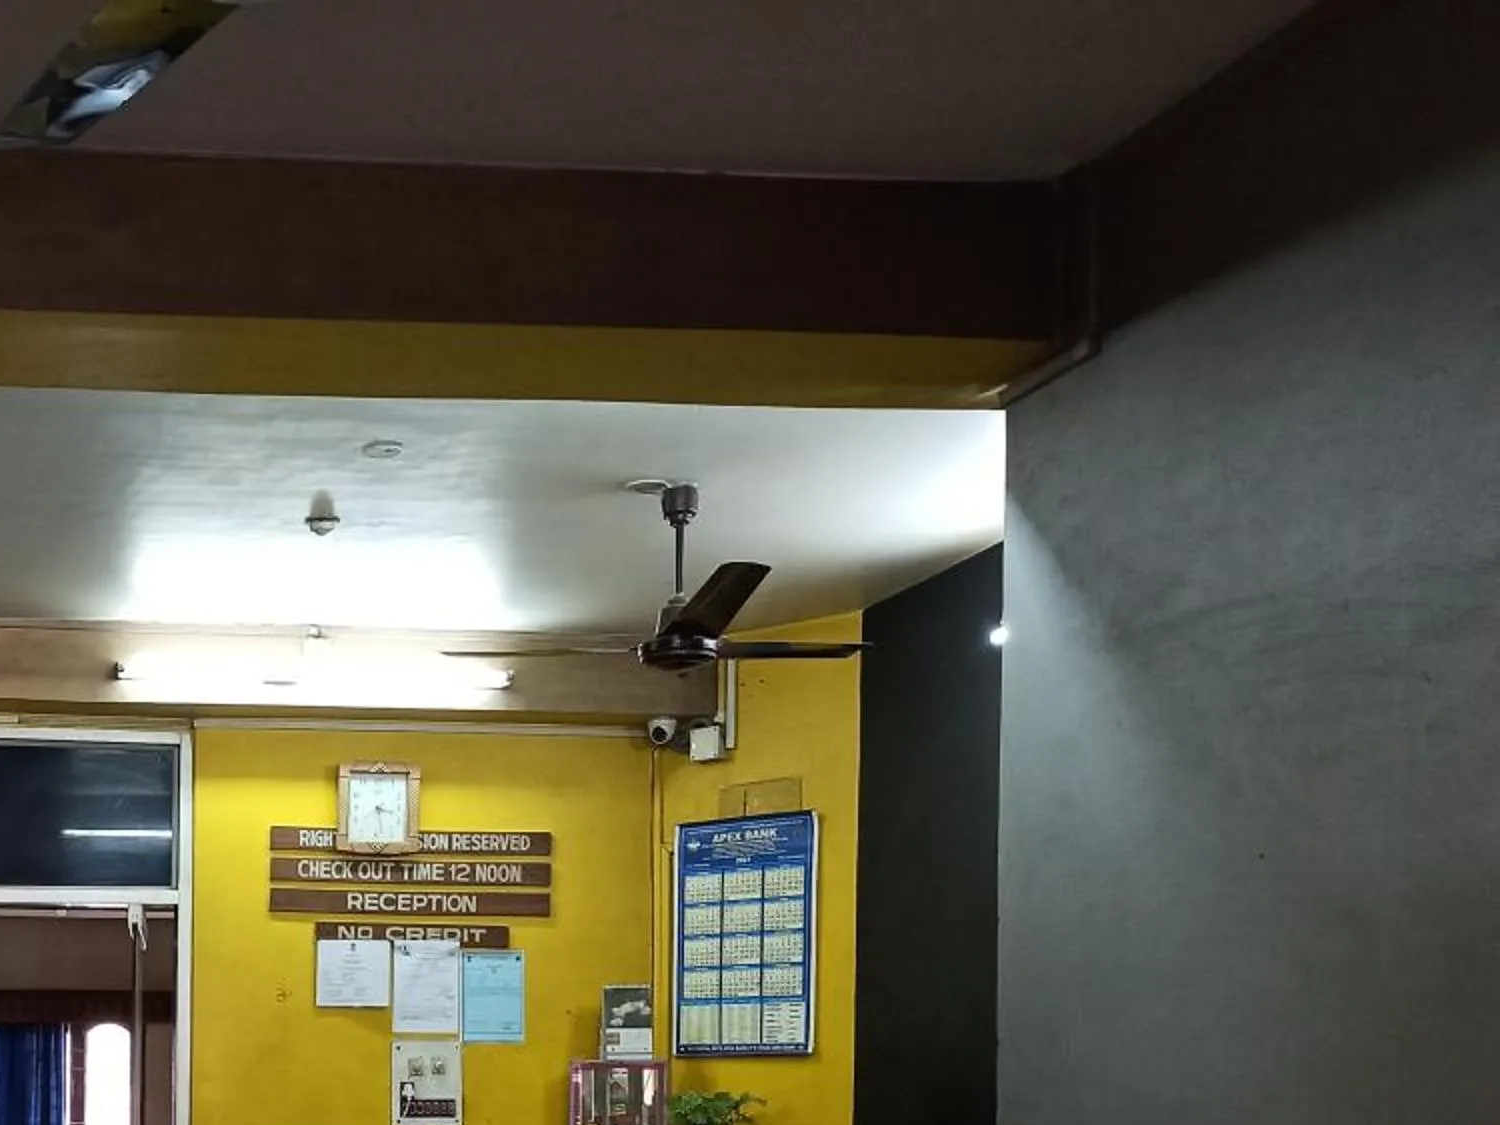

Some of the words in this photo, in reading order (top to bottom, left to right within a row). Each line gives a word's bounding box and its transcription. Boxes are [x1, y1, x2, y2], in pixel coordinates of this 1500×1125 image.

[452, 833, 531, 851] RESERVED
[712, 831, 742, 843] APEX
[744, 827, 778, 841] BANK
[298, 860, 353, 880] CHECK
[357, 861, 394, 881] OUT
[401, 862, 444, 882] TIME
[449, 863, 470, 882] 12
[475, 863, 522, 883] NOON
[347, 892, 477, 912] RECEPTION
[337, 925, 373, 940] NO
[385, 926, 487, 943] CREDIT
